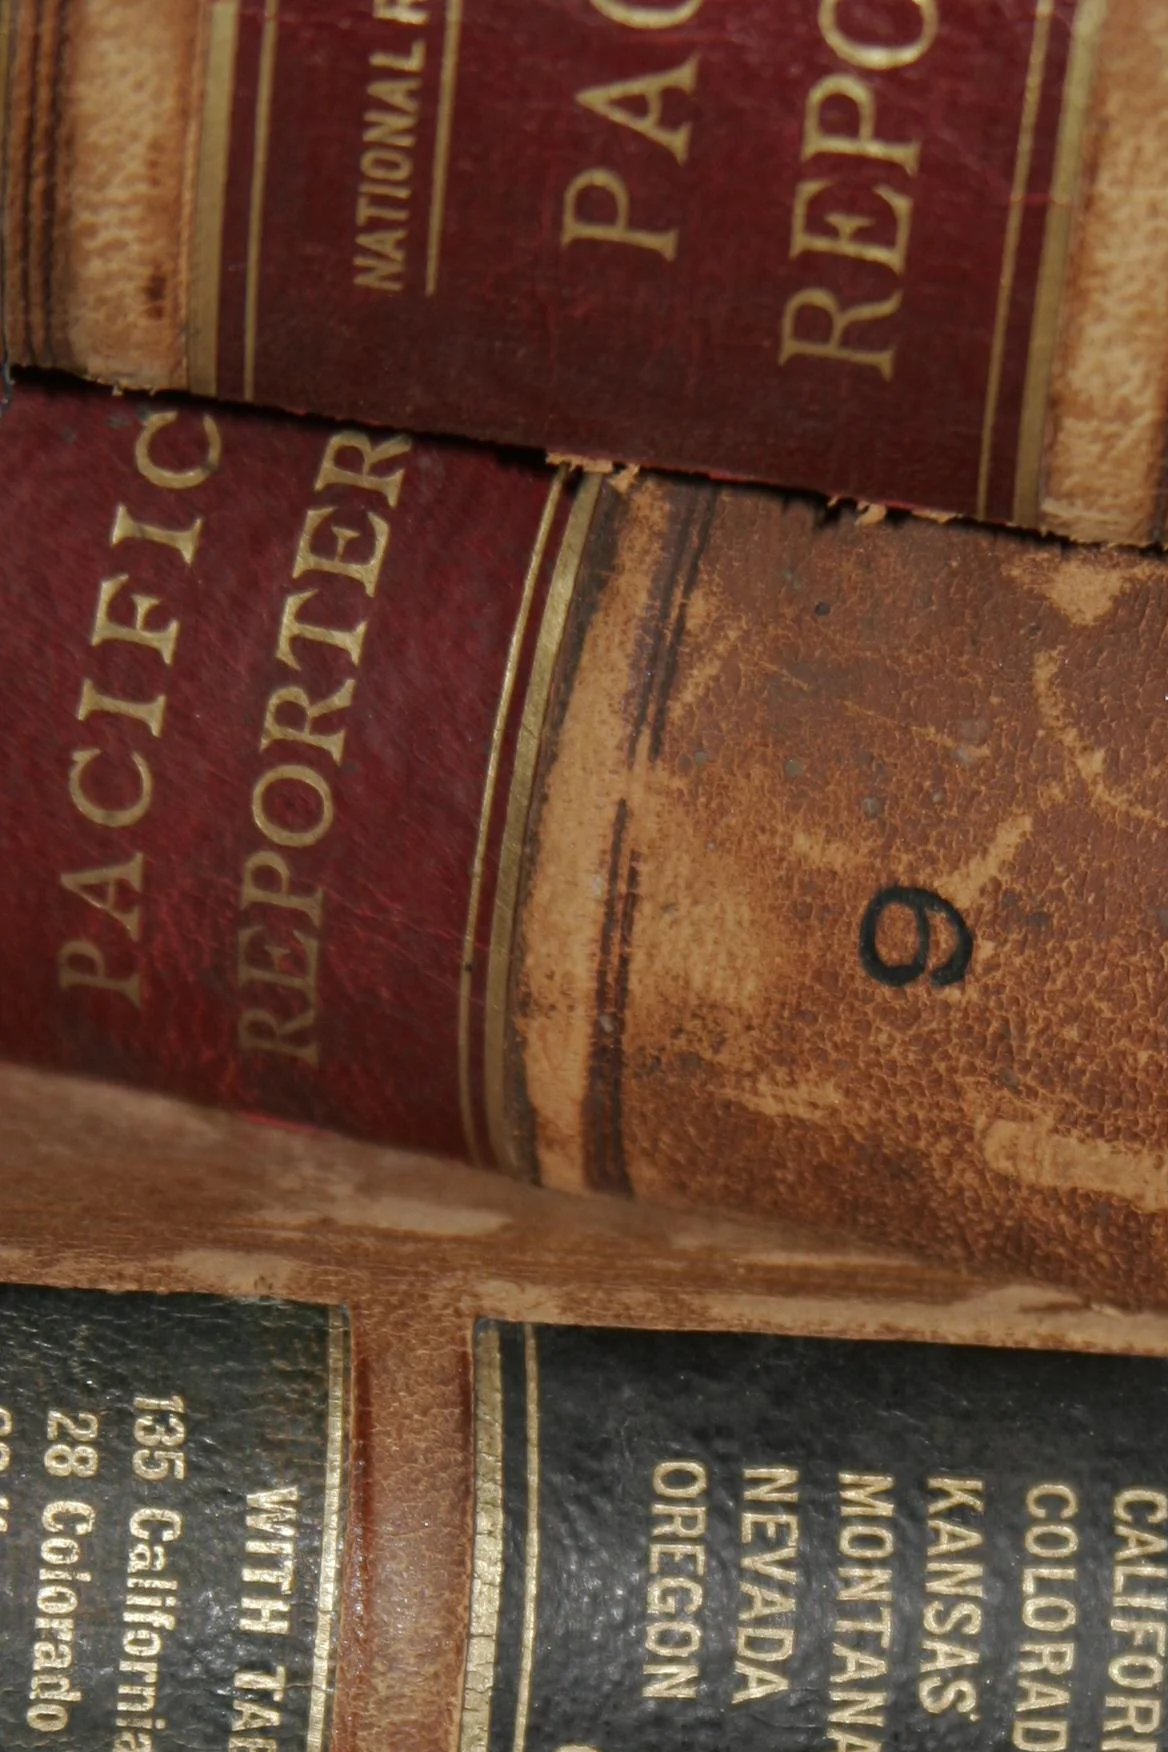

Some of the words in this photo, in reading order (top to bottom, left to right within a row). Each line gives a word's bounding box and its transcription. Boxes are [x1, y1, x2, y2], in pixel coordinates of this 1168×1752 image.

[354, 39, 425, 291] NATIONAL
[778, 0, 938, 381] REPO
[59, 410, 222, 1007] PACIFIC
[238, 429, 413, 1068] REPORTER
[44, 1409, 98, 1478] 28
[132, 1394, 186, 1481] 135
[237, 1486, 299, 1635] WITH
[642, 1459, 708, 1700] OREGON
[731, 1466, 799, 1704] NEVADA
[918, 1475, 987, 1716] KANSAS
